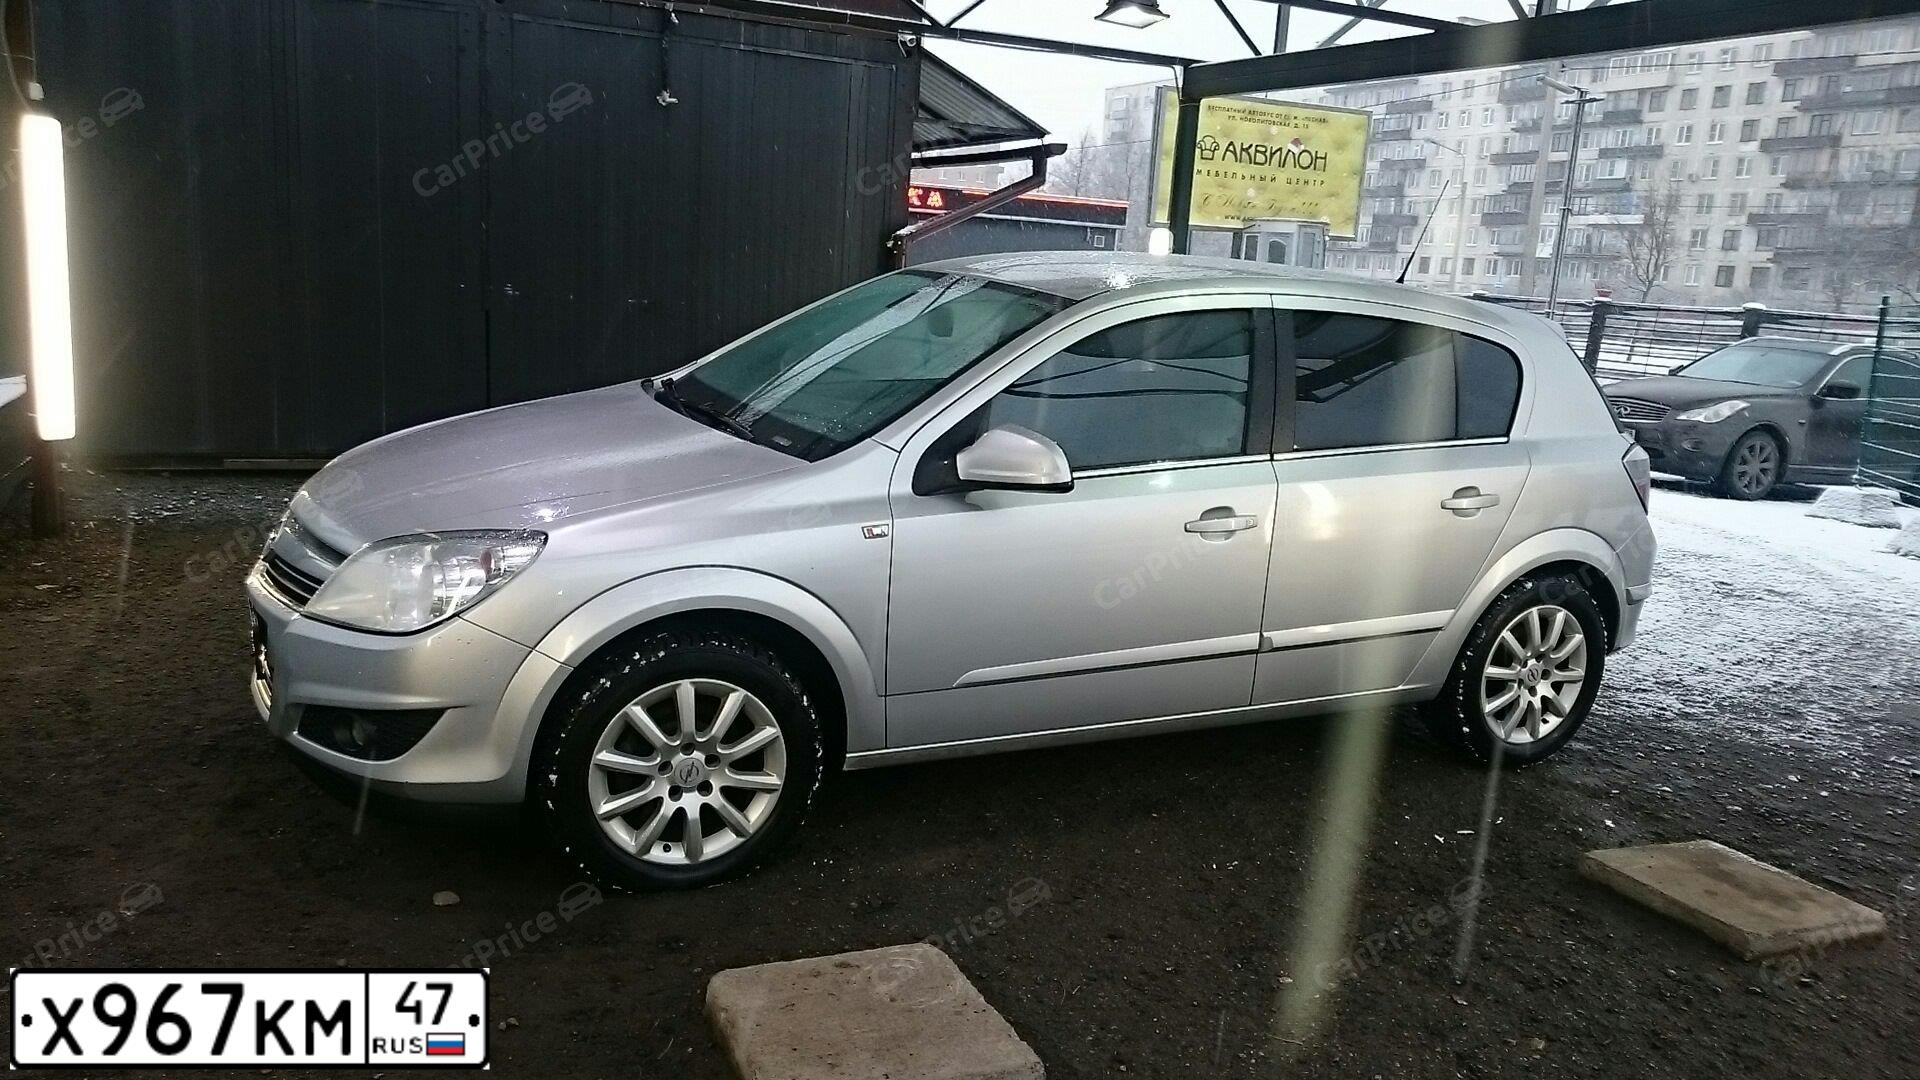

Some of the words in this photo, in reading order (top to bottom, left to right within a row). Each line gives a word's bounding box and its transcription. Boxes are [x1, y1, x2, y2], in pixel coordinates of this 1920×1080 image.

[1248, 109, 1275, 118] АВТОБУС
[1221, 140, 1328, 173] АКВИЛОН
[1196, 168, 1277, 183] МЕБЕЛЬНЫЙ
[1286, 177, 1325, 187] ЦЕНТР
